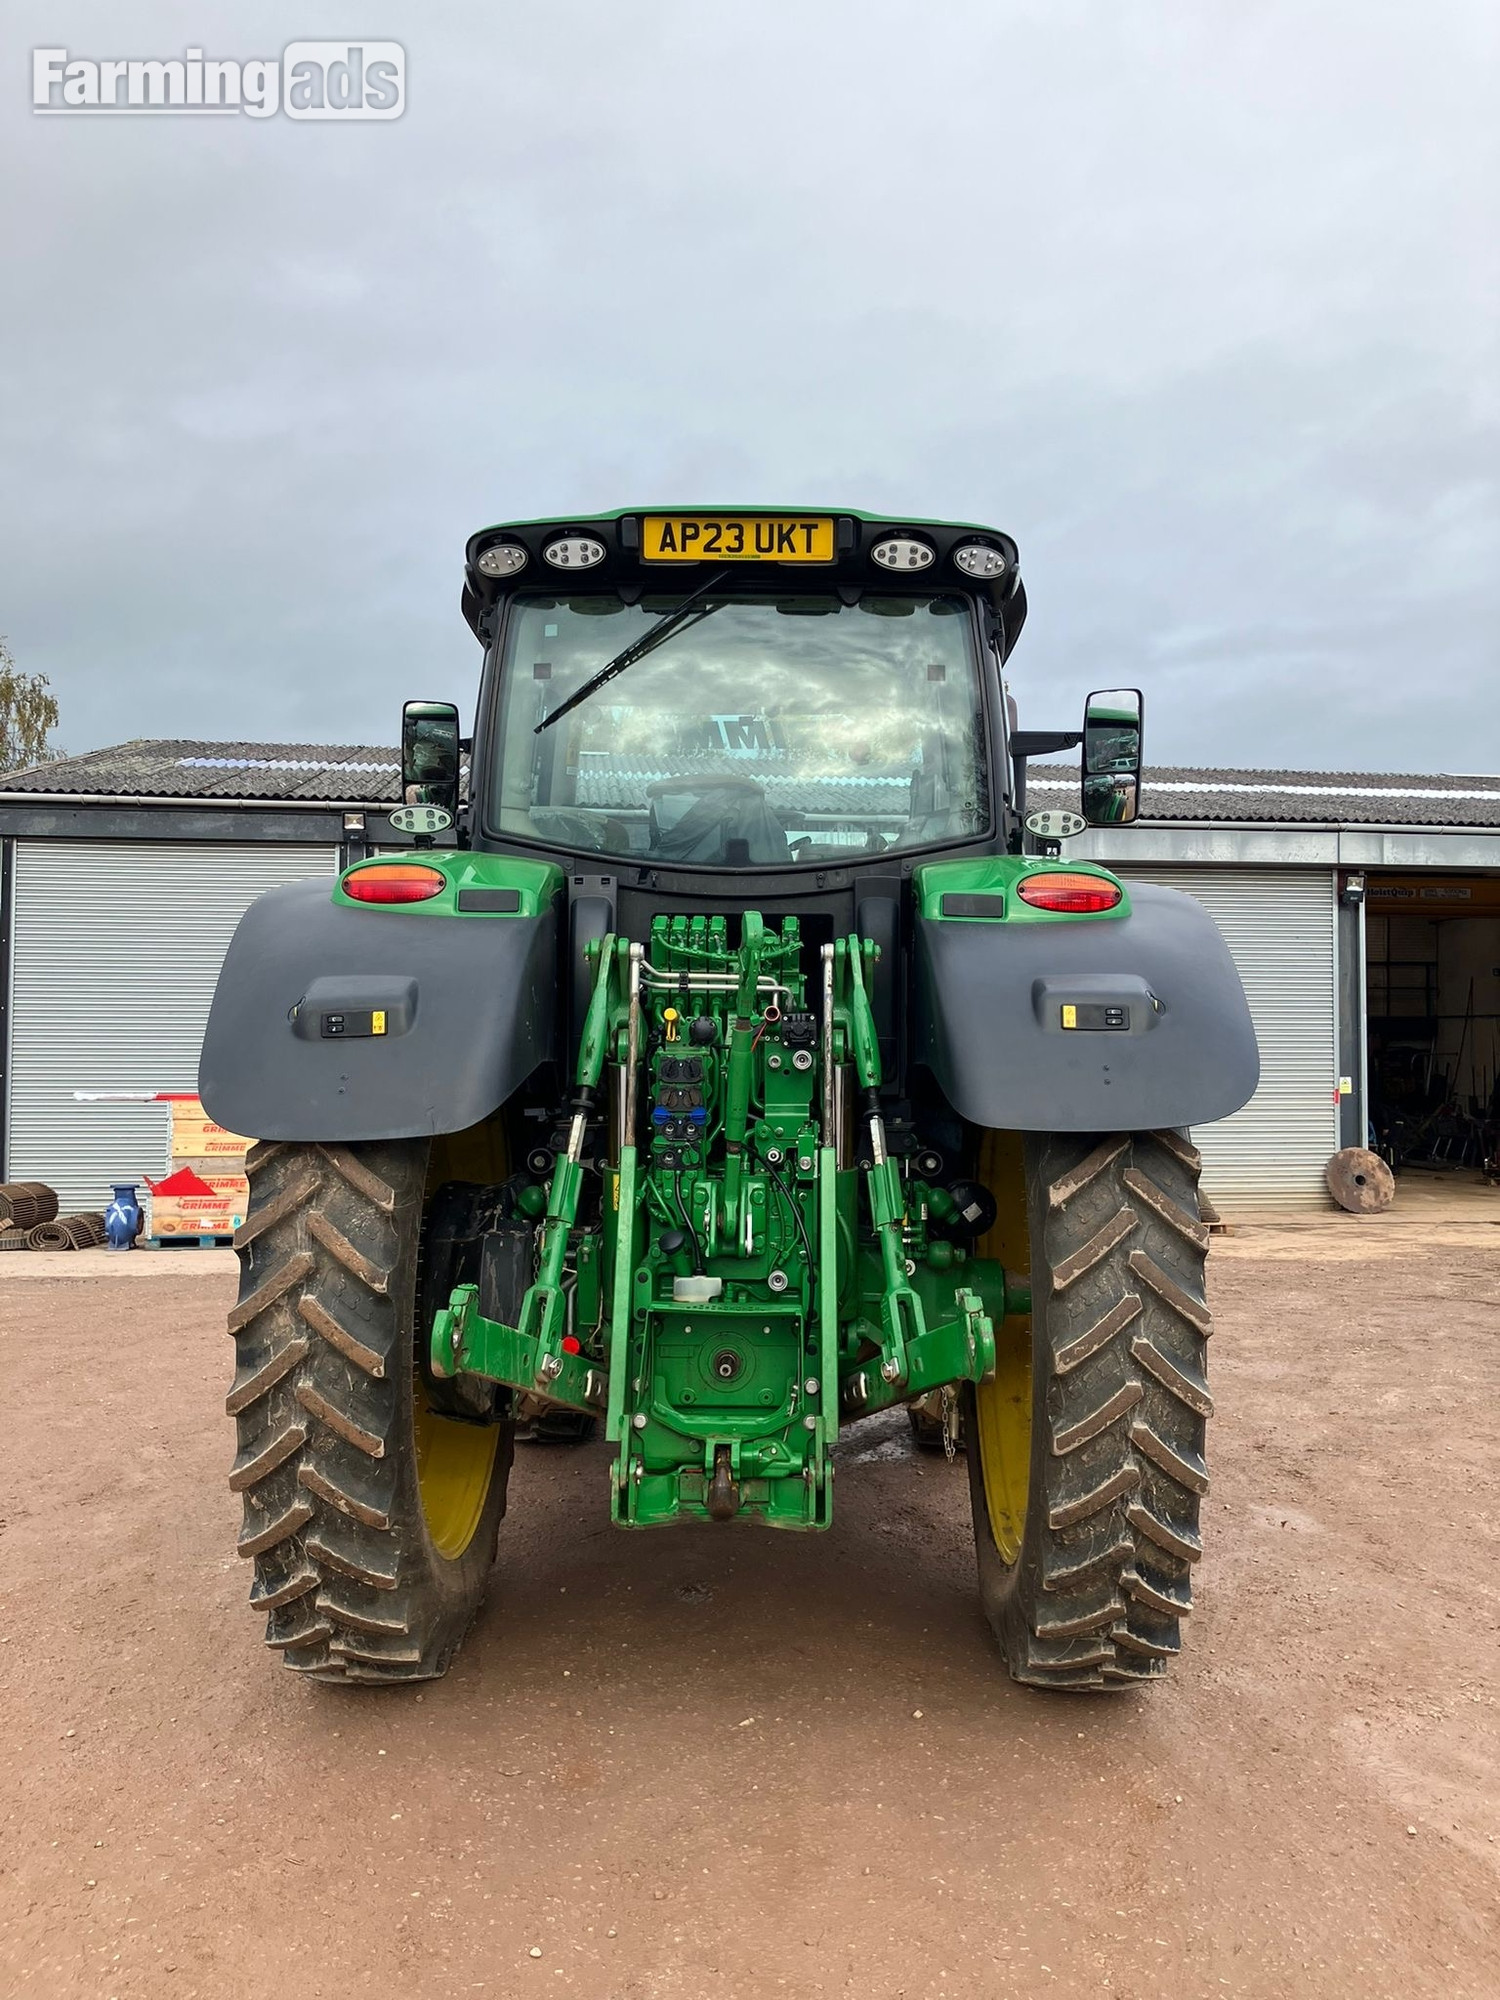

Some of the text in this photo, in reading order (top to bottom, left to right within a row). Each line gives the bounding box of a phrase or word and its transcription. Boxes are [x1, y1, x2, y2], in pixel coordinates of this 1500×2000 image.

[659, 522, 818, 553] AP23 UKT
[181, 1221, 230, 1229] GRIME
